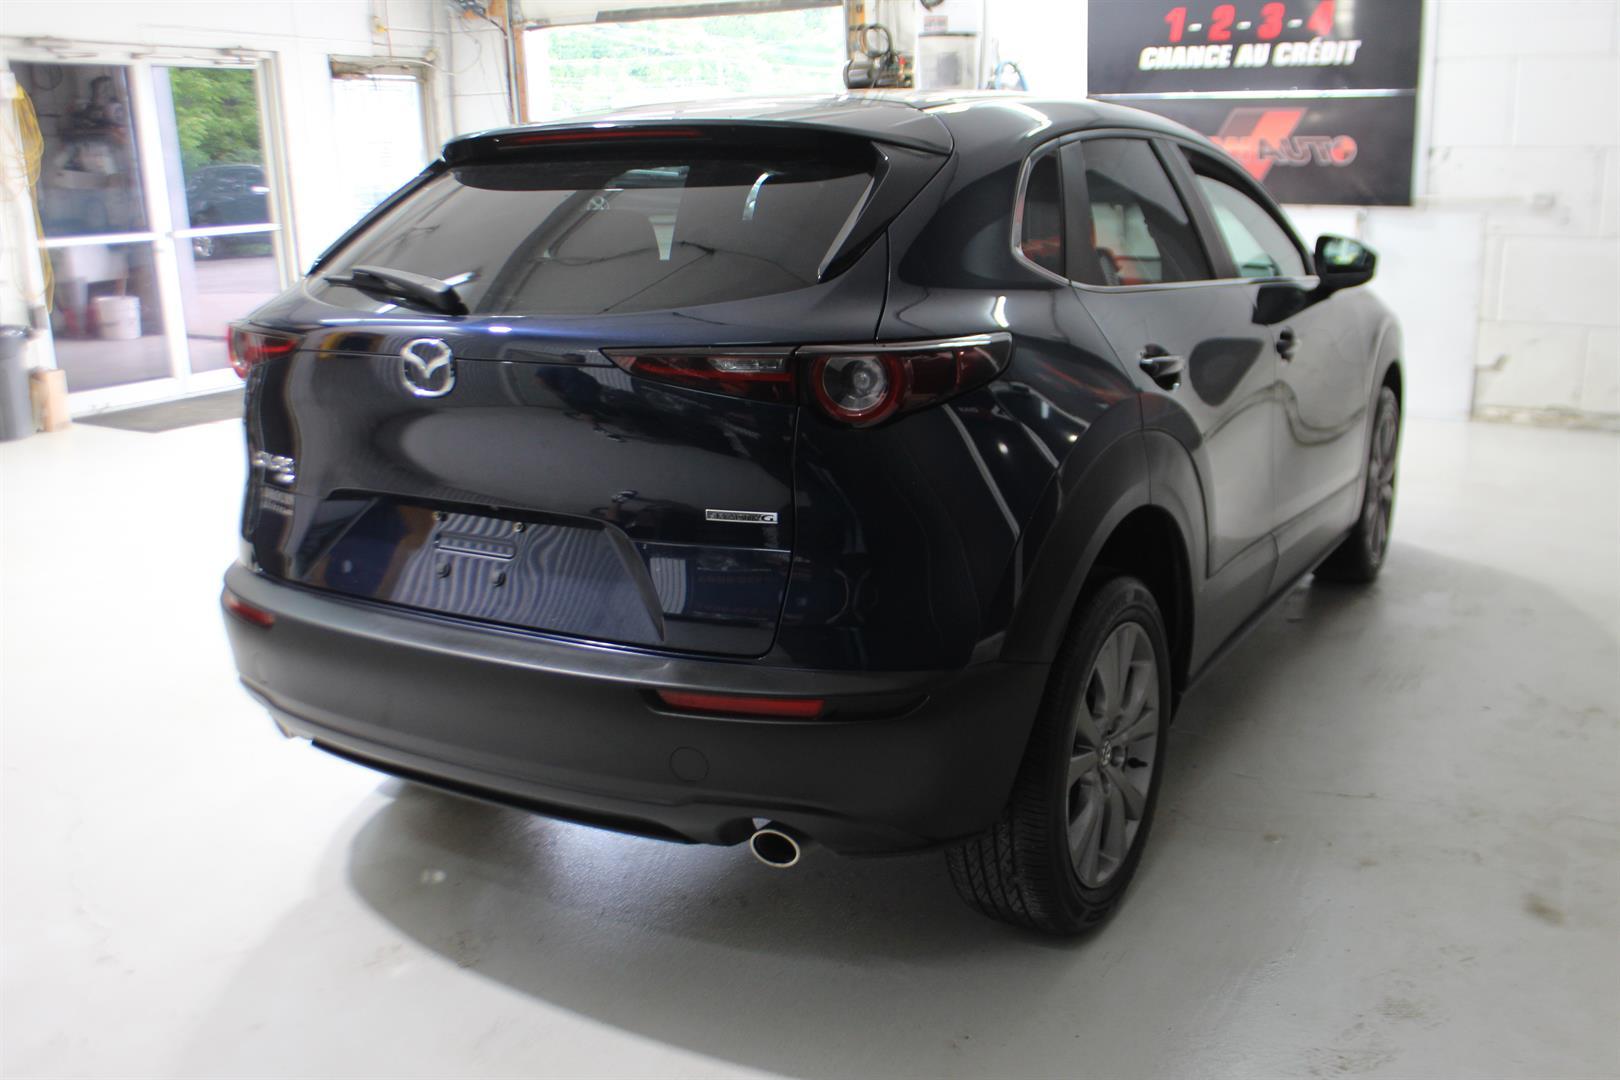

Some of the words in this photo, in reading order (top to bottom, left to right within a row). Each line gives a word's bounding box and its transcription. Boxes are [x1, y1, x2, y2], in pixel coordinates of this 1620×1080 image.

[1139, 45, 1233, 70] CHANCE
[1234, 43, 1271, 67] AU
[1272, 36, 1361, 67] CRÉDIT
